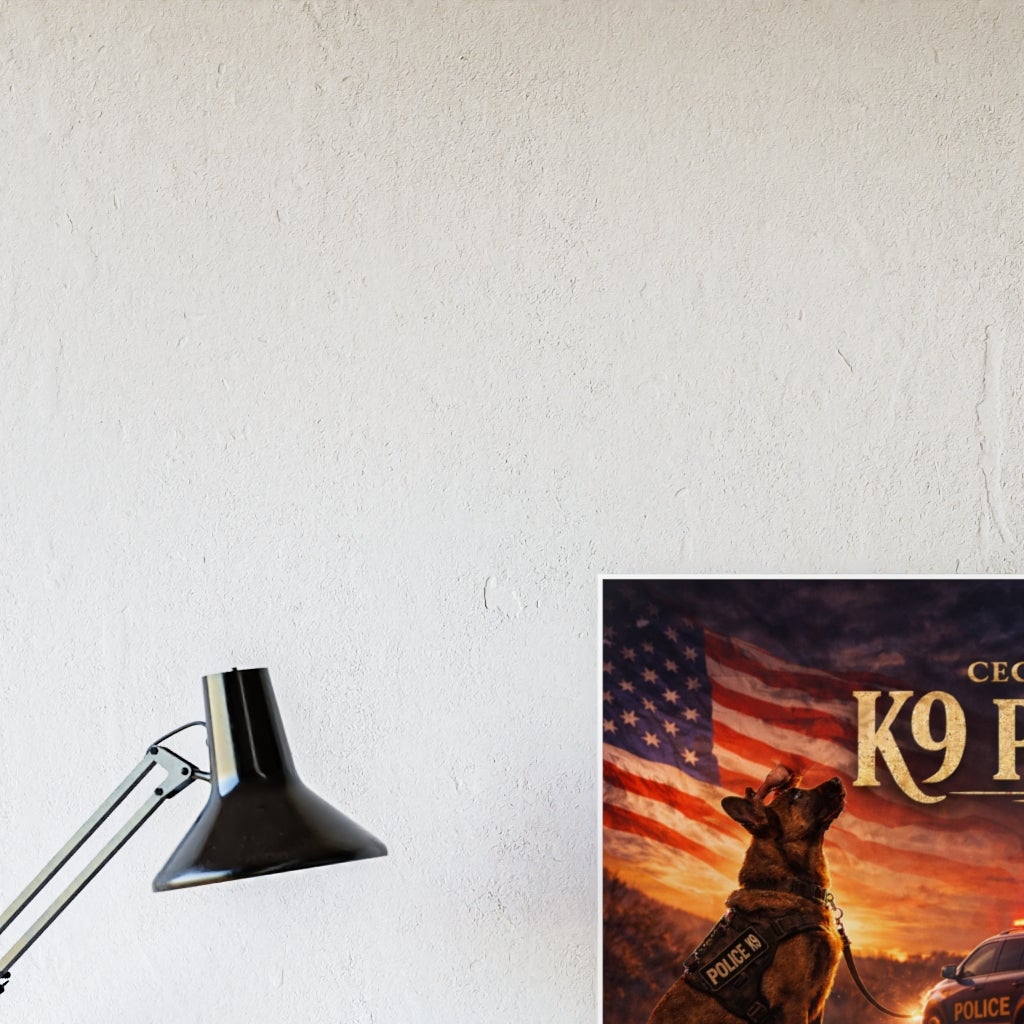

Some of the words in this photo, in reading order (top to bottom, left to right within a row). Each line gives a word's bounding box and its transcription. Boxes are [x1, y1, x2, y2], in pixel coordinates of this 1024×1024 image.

[852, 690, 967, 804] K9
[706, 944, 751, 985] POLICE
[744, 933, 762, 952] K9
[954, 996, 1010, 1021] POLICE
